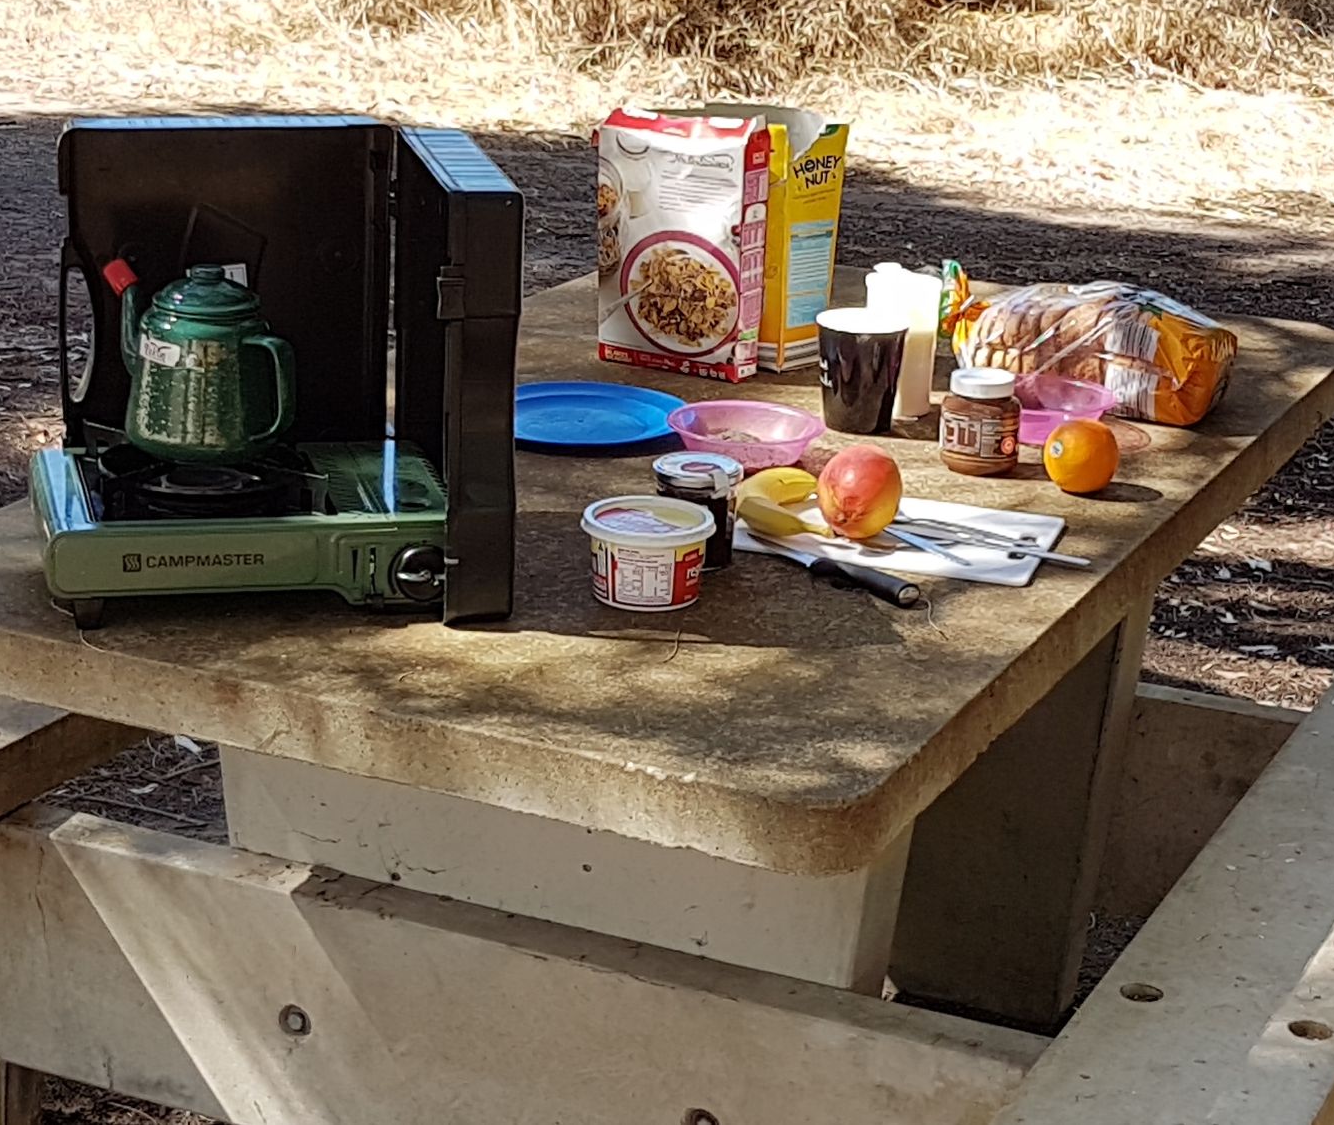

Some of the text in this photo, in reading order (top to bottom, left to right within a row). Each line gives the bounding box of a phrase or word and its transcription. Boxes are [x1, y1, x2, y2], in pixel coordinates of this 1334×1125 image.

[792, 155, 842, 179] HONEY
[805, 170, 830, 189] NUT
[146, 553, 265, 569] CAMPMASTER
